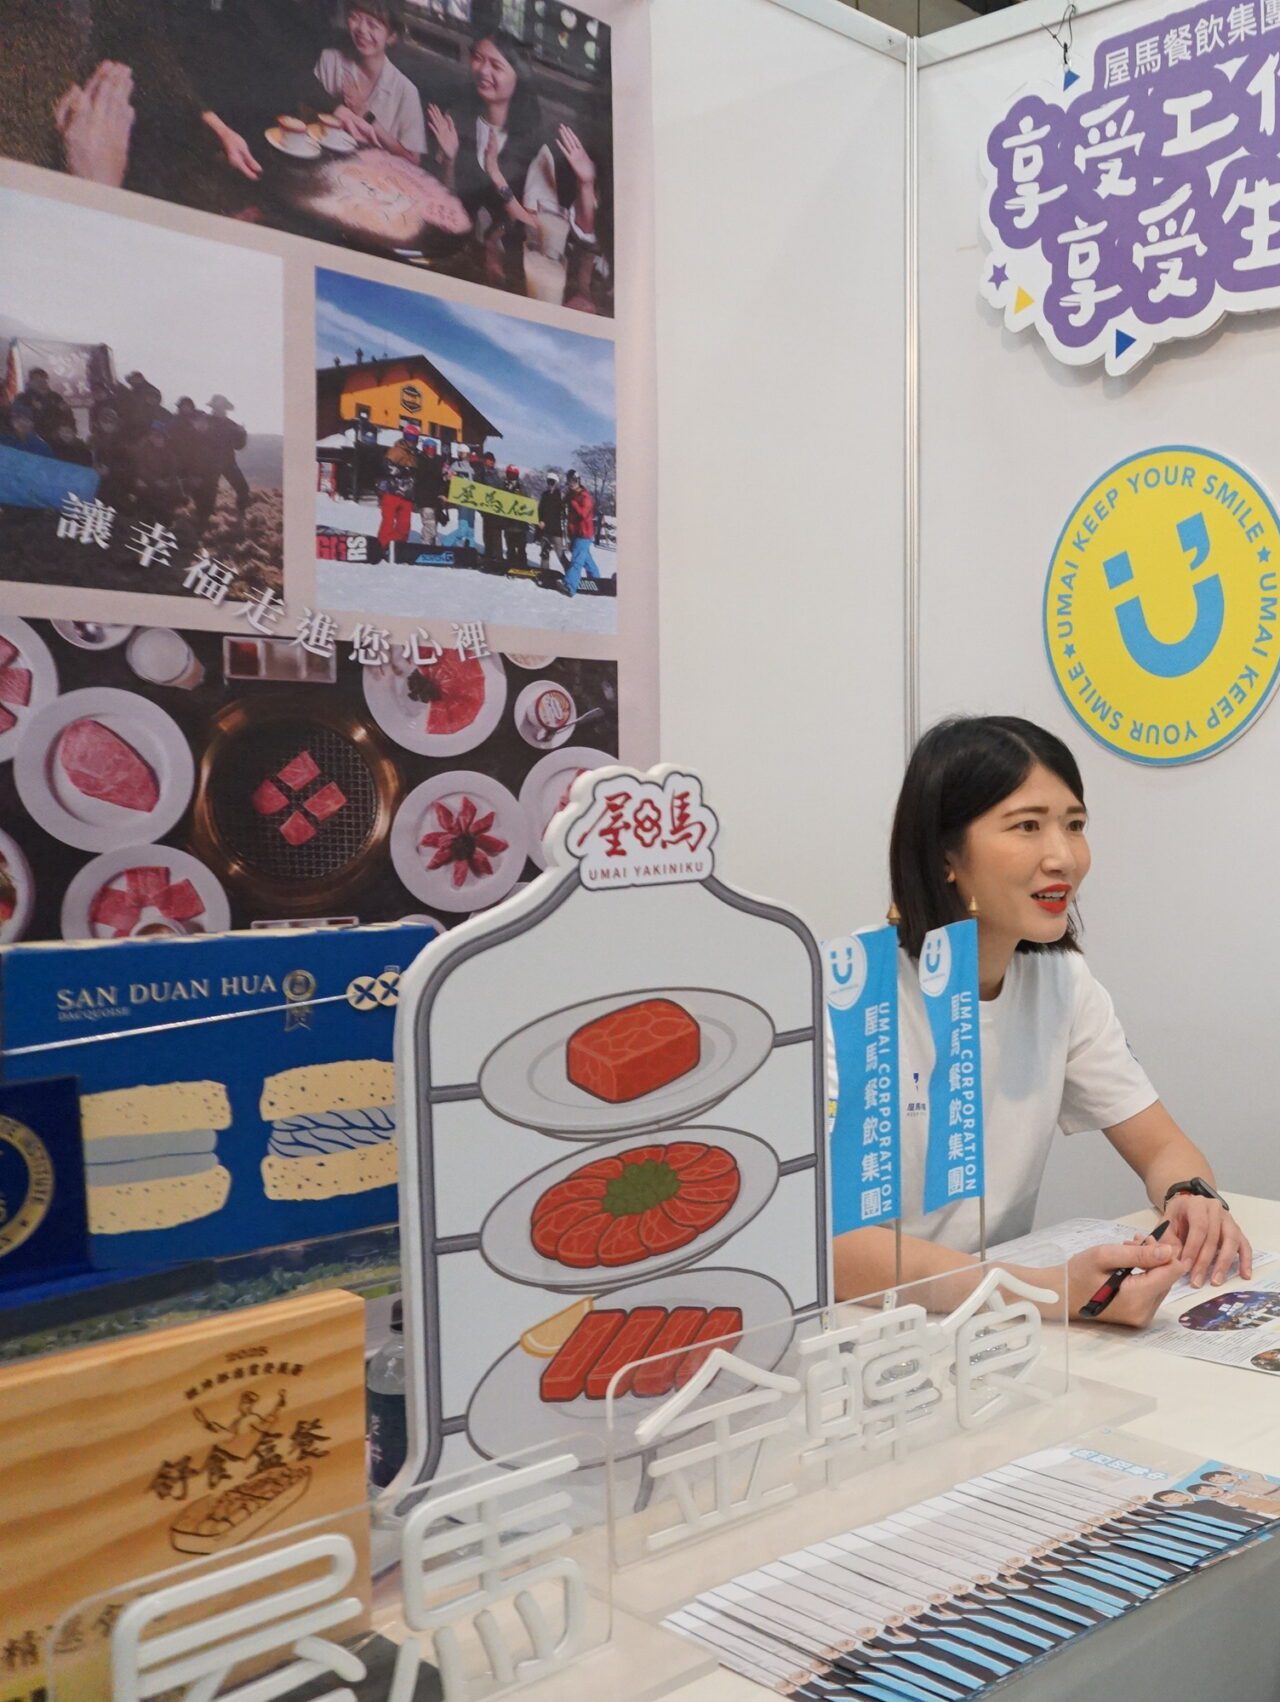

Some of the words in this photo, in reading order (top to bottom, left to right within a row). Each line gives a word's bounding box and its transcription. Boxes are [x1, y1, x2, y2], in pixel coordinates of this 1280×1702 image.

[1057, 560, 1079, 639] UMAI
[1072, 487, 1120, 552] KEEP
[1126, 464, 1197, 494] YOUR
[1202, 473, 1265, 543] SMILE
[1252, 571, 1278, 657] UMAI
[1067, 660, 1124, 731] SMILE
[1206, 664, 1260, 730] KEEP
[1129, 719, 1198, 745] YOUR
[577, 789, 708, 857] 屋馬
[588, 867, 627, 881] UMAI
[634, 861, 704, 877] YAKINIKU
[57, 985, 118, 1011] SAN
[129, 977, 211, 1005] DUAN
[221, 974, 277, 997] HUA
[959, 991, 972, 1041] UMAI
[878, 1002, 890, 1054] UMAI
[878, 1063, 893, 1213] CORPORATION
[960, 1049, 976, 1191] CORPORATION
